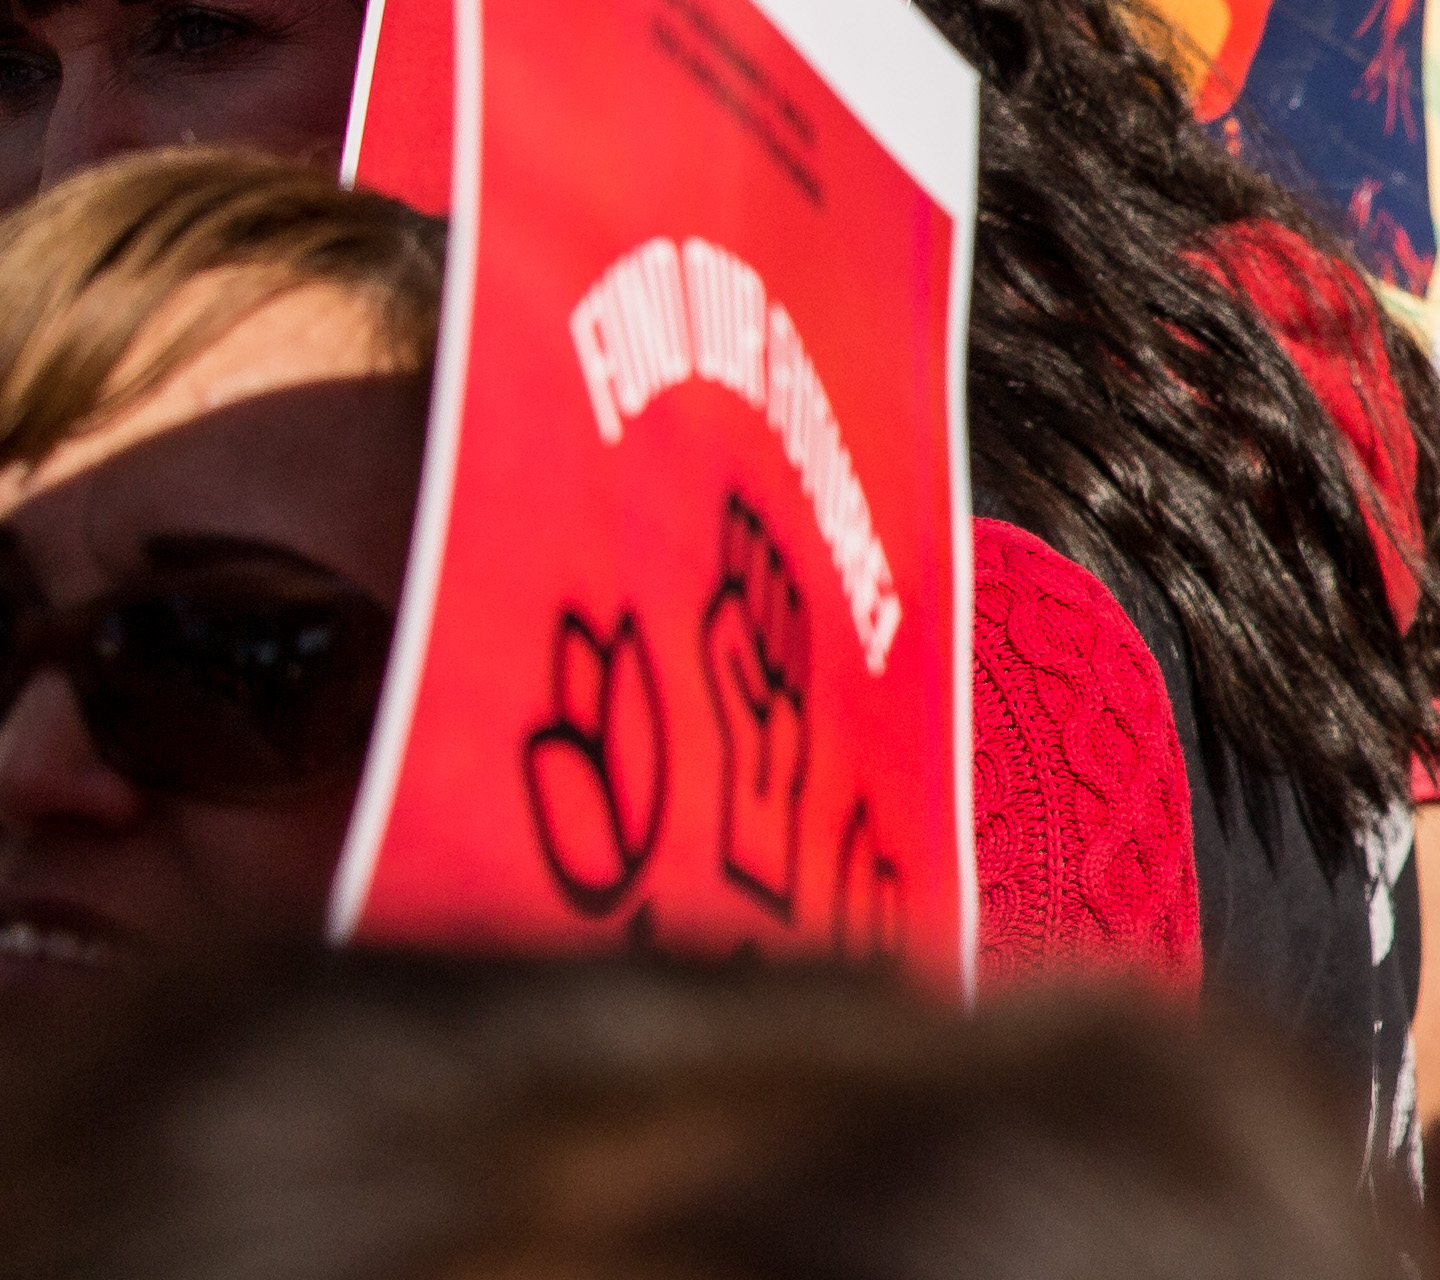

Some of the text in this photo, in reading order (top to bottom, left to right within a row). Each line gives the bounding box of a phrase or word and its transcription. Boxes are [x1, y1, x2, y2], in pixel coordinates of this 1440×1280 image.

[568, 234, 903, 677] FUND OUR FUTURE!
